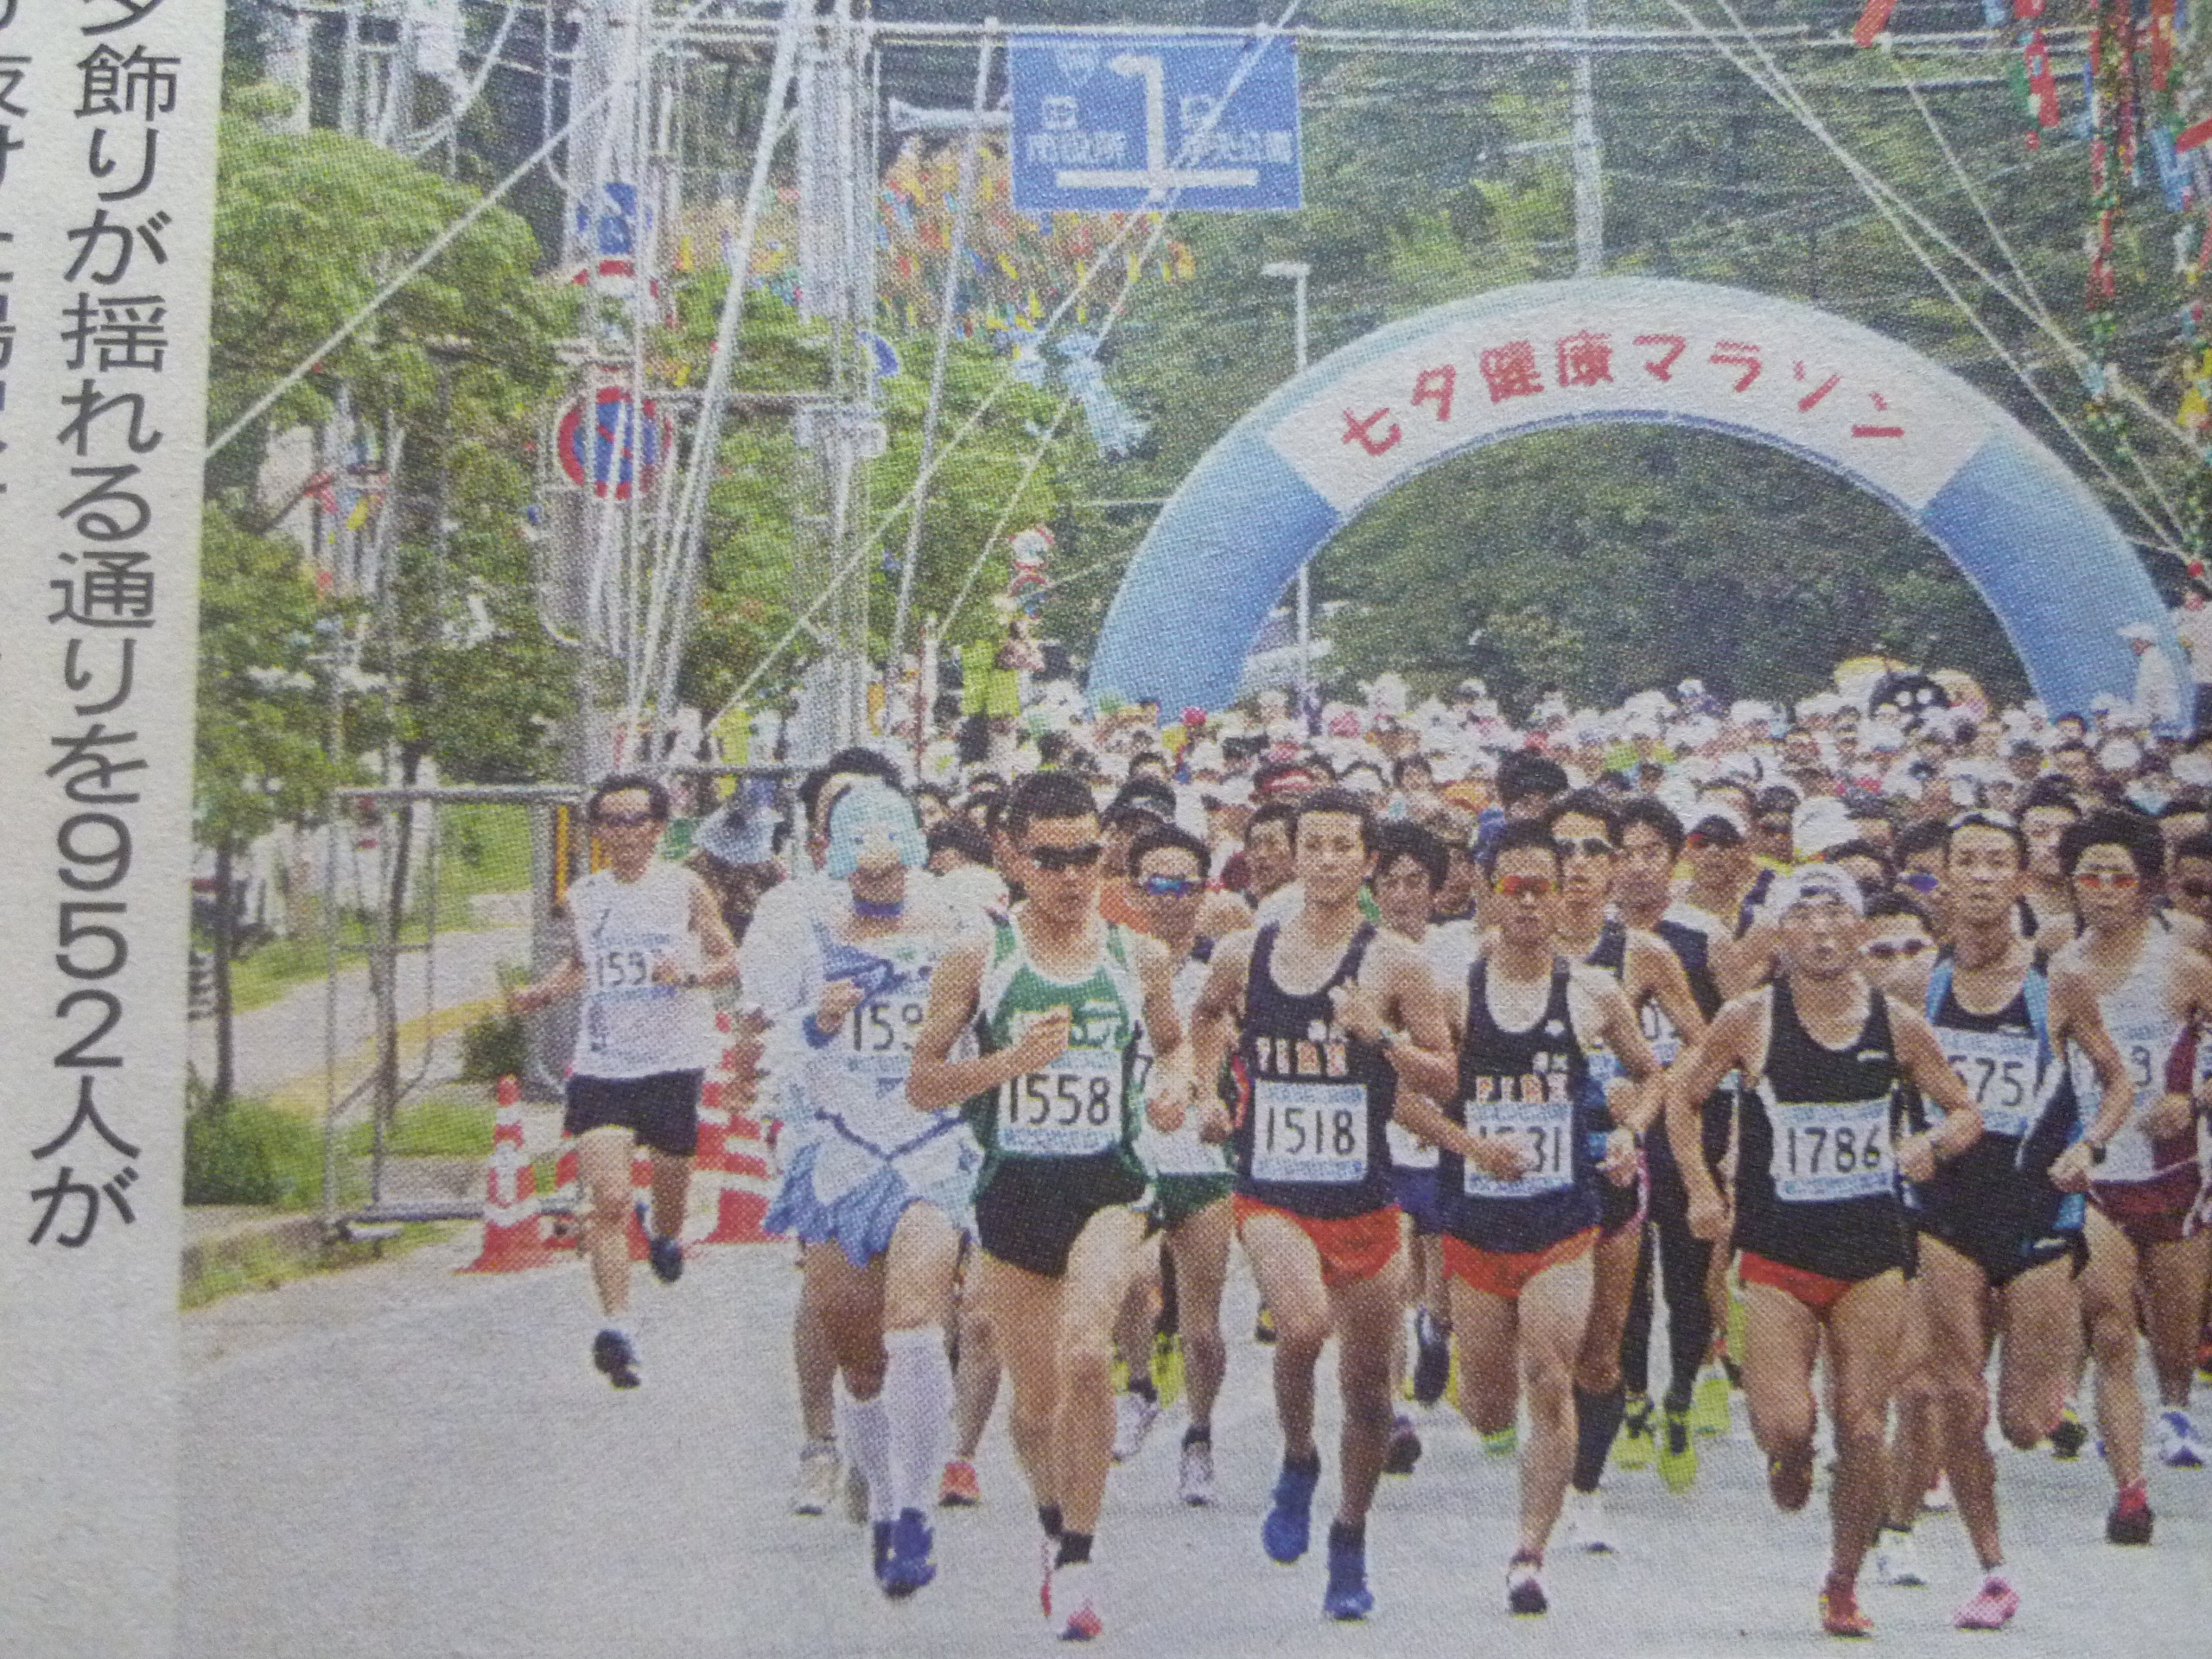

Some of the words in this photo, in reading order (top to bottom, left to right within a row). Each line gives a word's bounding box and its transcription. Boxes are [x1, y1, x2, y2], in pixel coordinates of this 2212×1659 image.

[1342, 329, 1905, 456] 七夕健康マラソン
[1009, 1073, 1110, 1125] 1558
[1266, 1107, 1355, 1155] 1518
[1787, 1125, 1881, 1175] 1786
